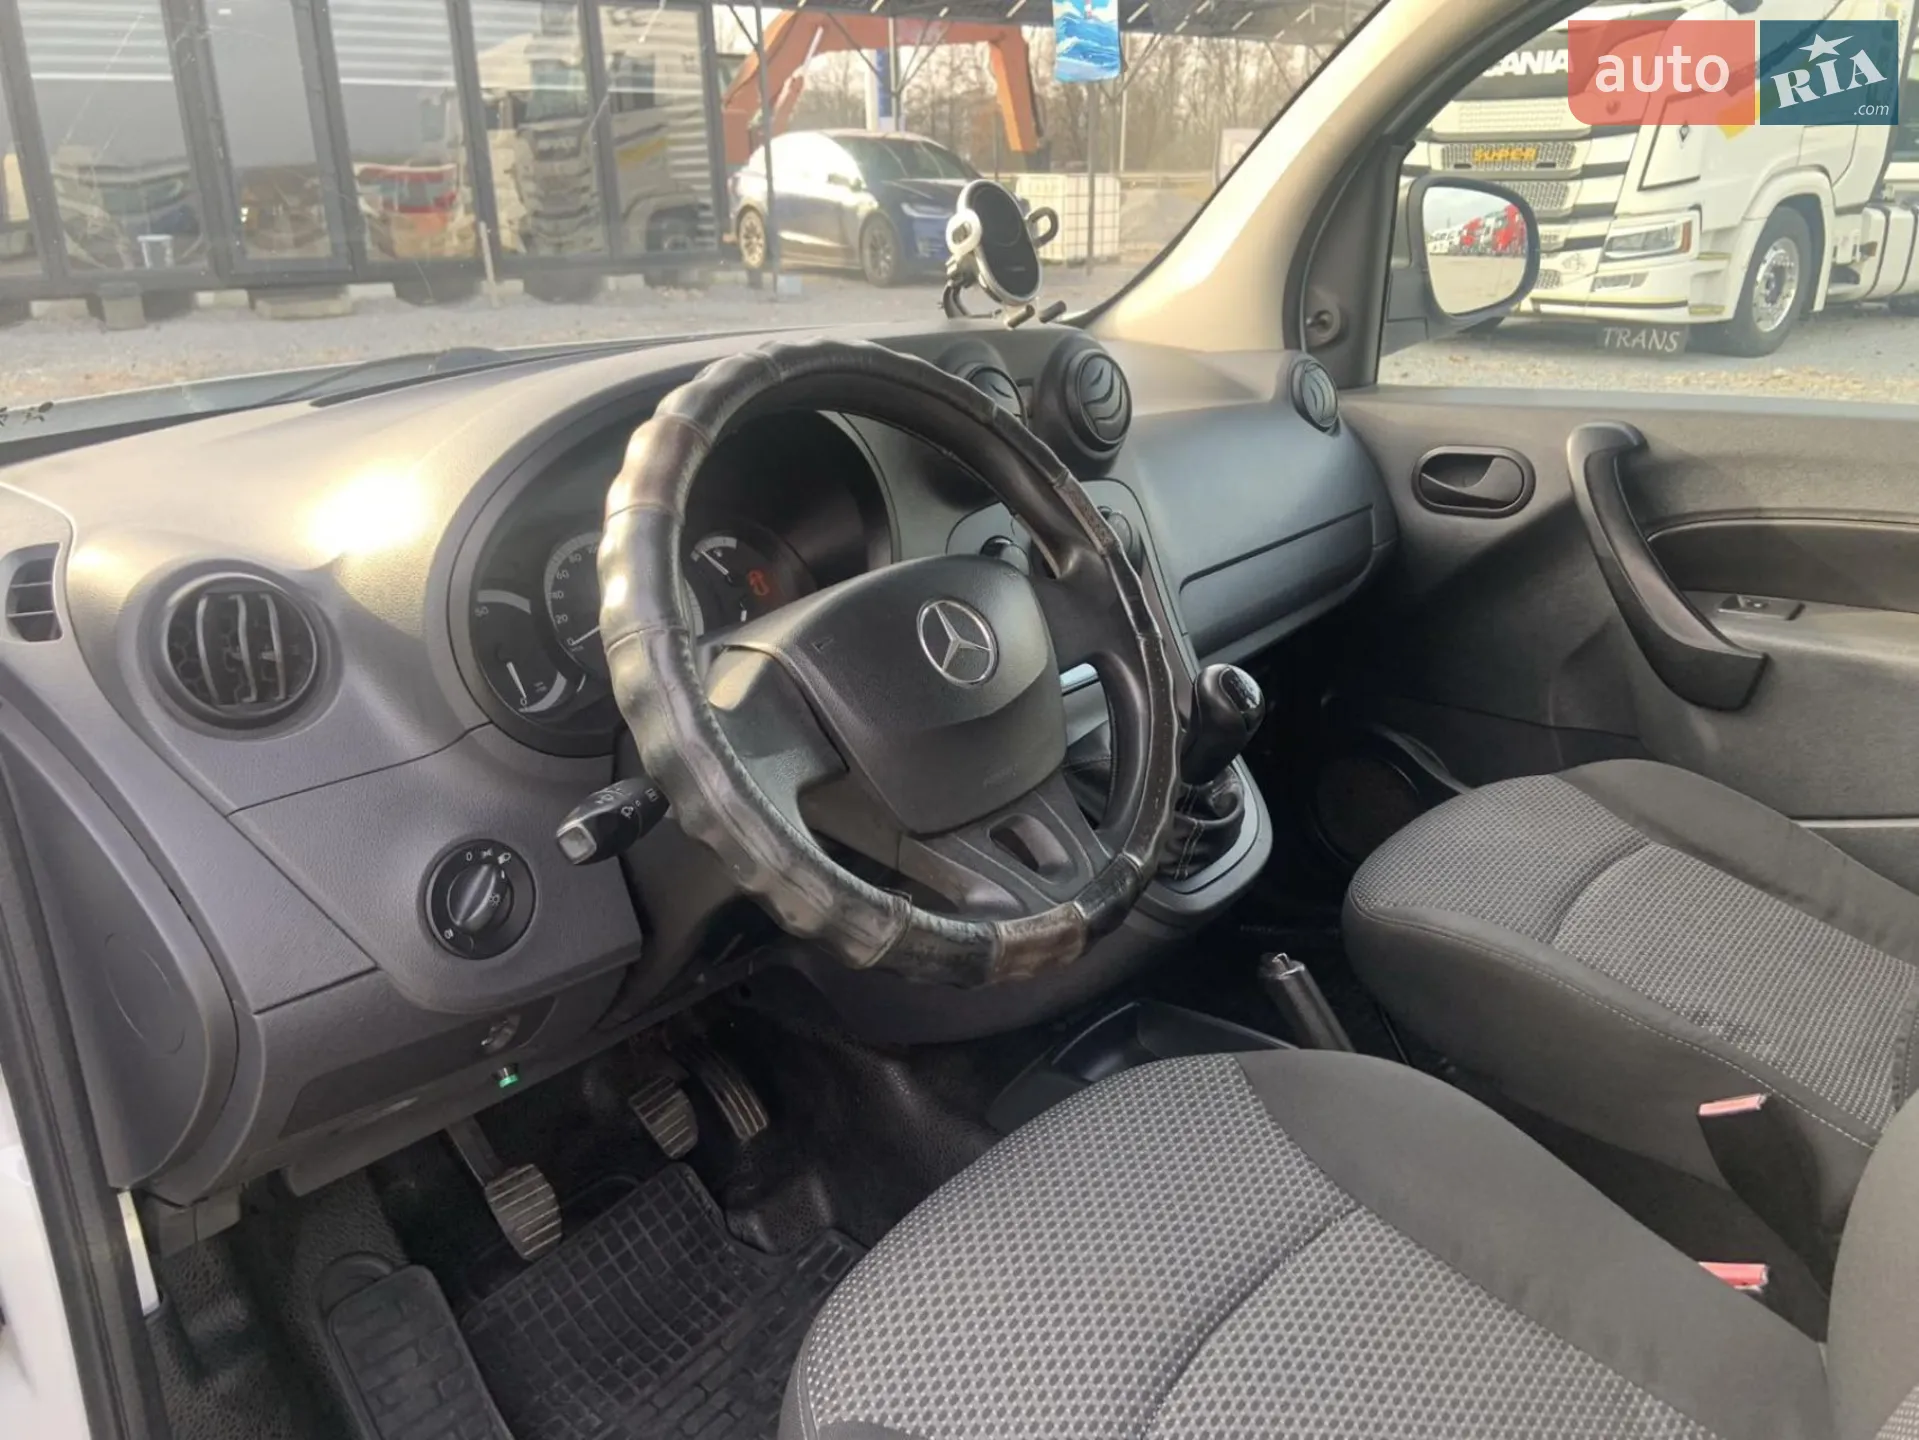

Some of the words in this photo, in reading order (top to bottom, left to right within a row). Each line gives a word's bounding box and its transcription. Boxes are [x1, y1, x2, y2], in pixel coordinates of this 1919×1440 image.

[1473, 146, 1537, 162] SUPER
[1603, 326, 1681, 353] TRANS
[555, 614, 568, 624] 20
